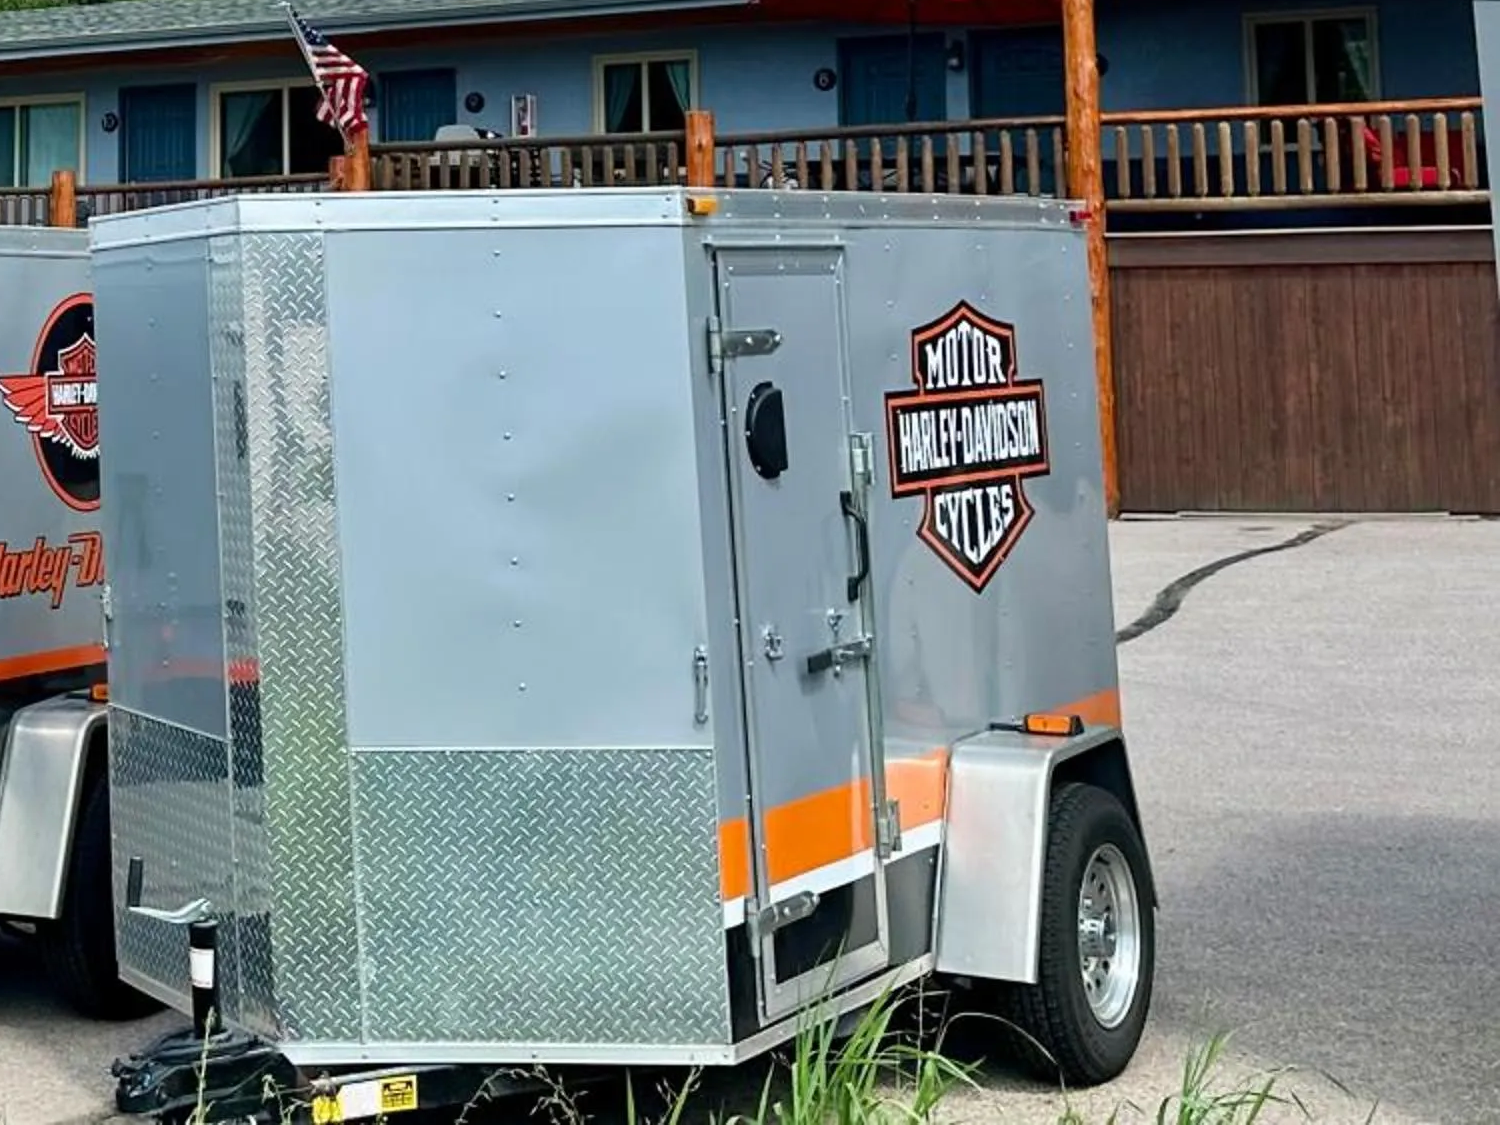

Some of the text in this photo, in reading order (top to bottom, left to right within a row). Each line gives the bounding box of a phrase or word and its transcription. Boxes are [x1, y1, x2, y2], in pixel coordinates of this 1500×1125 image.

[925, 320, 1007, 389] MOTOR
[897, 399, 1041, 474] HARLEY-DAVIDSON
[933, 483, 1014, 566] CYCLES
